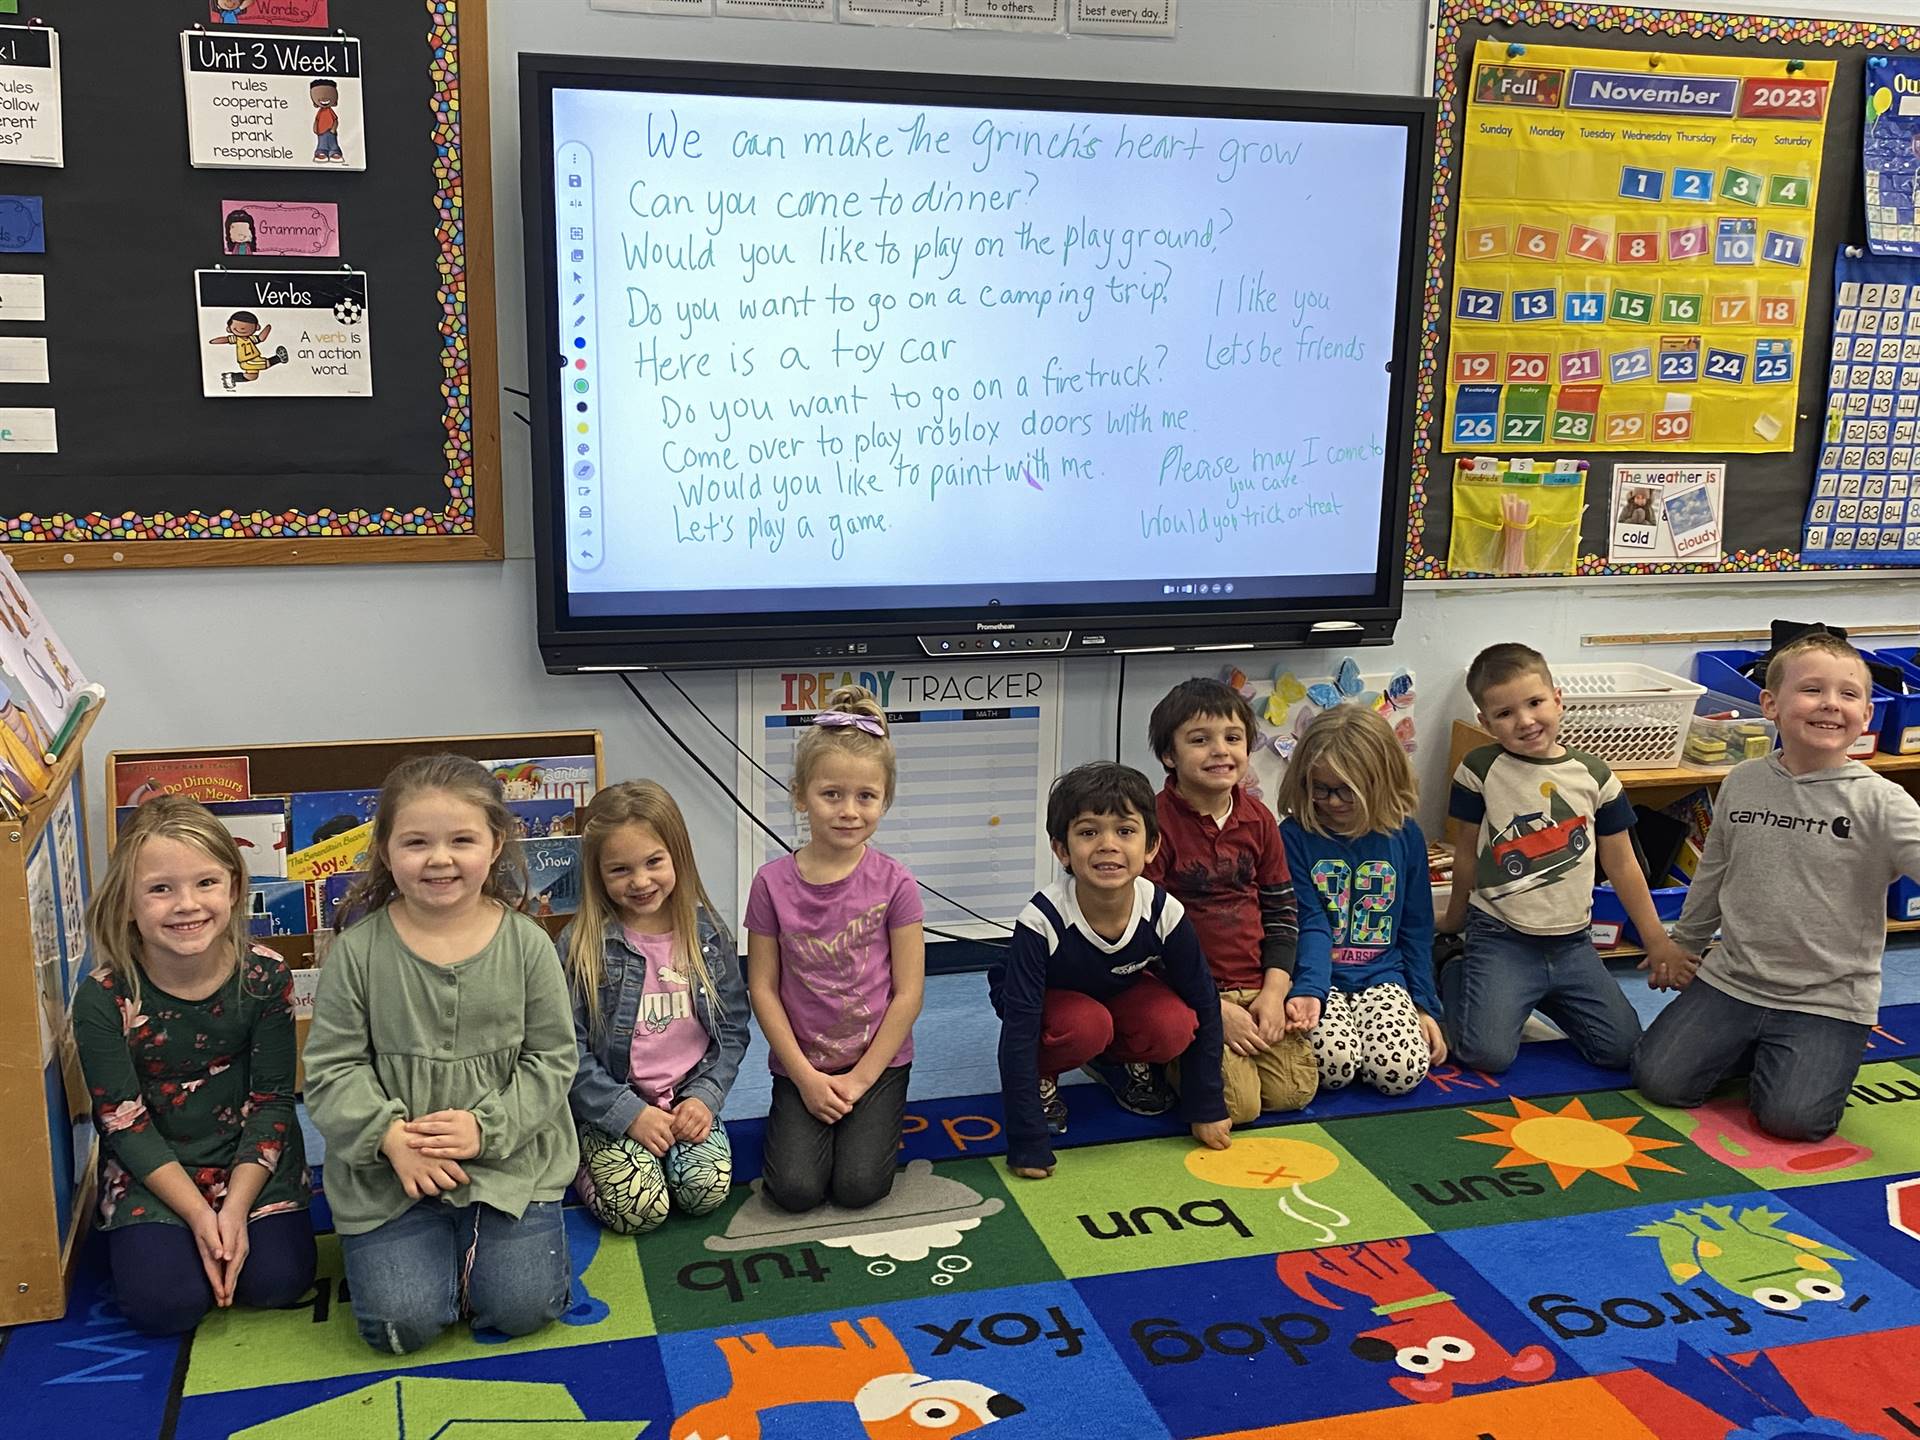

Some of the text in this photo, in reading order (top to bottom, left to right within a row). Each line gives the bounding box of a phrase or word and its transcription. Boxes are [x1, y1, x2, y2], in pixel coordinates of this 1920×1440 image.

[256, 0, 299, 16] Words
[988, 1, 1036, 14] to others.
[1086, 7, 1161, 22] best every day.
[198, 41, 246, 70] Unit
[251, 43, 269, 70] 3
[274, 44, 338, 74] Week
[231, 78, 269, 92] rules
[1501, 79, 1817, 109] Fall November 2023
[213, 94, 289, 112] cooperate
[231, 112, 274, 128] guard
[231, 128, 274, 144] prank
[648, 109, 703, 159] We
[733, 130, 787, 160] can
[804, 117, 894, 159] make
[1114, 123, 1207, 161] heart
[1216, 137, 1303, 184] grow
[1480, 123, 1813, 149] Sunday Monday Tuesday Wednesday Thursday Friday Saturday
[213, 144, 294, 162] responsible
[1732, 176, 1749, 196] 3
[629, 170, 1040, 236] Can you come to dinner?
[258, 221, 322, 238] Grammar
[621, 231, 717, 272] Would
[739, 244, 796, 283] you
[820, 226, 869, 266] like
[873, 230, 901, 265] to
[913, 226, 963, 281] play
[974, 234, 1005, 258] on
[1014, 220, 1056, 256] the
[1723, 239, 1749, 258] 10
[255, 281, 313, 307] Verbs
[1237, 269, 1279, 315] like
[1292, 286, 1332, 329] you
[628, 286, 662, 329] Do
[676, 299, 721, 340] you
[739, 284, 818, 319] want
[824, 282, 855, 313] to
[864, 296, 897, 332] go
[907, 288, 938, 309] on
[946, 286, 968, 308] a
[979, 280, 1096, 323] camping
[1720, 299, 1743, 318] 17
[300, 330, 362, 344] A verb is
[1258, 334, 1283, 369] be
[1294, 325, 1368, 362] friends
[240, 341, 256, 357] 27
[297, 346, 362, 360] an action
[633, 329, 958, 386] Here is a toy car
[1856, 343, 1874, 358] 22
[1462, 358, 1491, 377] 19
[661, 395, 698, 430] Do
[708, 400, 774, 442] you
[788, 384, 869, 419] want
[889, 382, 922, 409] to
[931, 385, 960, 424] go
[972, 376, 1003, 400] on
[1016, 373, 1029, 398] a
[662, 440, 740, 475] Come
[748, 438, 805, 463] over
[817, 424, 845, 458] to
[854, 421, 903, 467] play
[917, 406, 1001, 447] roblox
[1021, 409, 1093, 437] doors
[1107, 403, 1154, 437] with
[1459, 419, 1493, 437] 26
[1159, 432, 1384, 487] Please may I come to
[1867, 451, 1886, 466] 63
[677, 472, 763, 509] Would
[773, 472, 822, 512] you
[836, 460, 884, 495] like
[894, 454, 921, 488] to
[931, 454, 1001, 501] paint
[1005, 446, 1051, 482] with
[1619, 470, 1716, 484] The weather is
[1225, 476, 1256, 510] you
[1140, 504, 1209, 540] Would
[1240, 505, 1284, 531] trick
[1288, 504, 1304, 519] or
[1304, 492, 1344, 518] treat
[673, 504, 734, 544] Let's
[748, 508, 786, 553] play
[797, 517, 815, 540] a
[1622, 529, 1650, 545] cold
[1835, 531, 1853, 546] 92
[1677, 528, 1720, 552] cloudy
[976, 622, 1016, 631] Promethean
[902, 671, 1043, 702] TRACKER
[888, 714, 904, 723] ELA
[976, 710, 998, 718] MATH
[164, 775, 244, 796] Do Dinosaurs
[543, 767, 590, 782] Santa's
[1729, 808, 1828, 835] carhartt
[312, 857, 338, 877] Joy
[340, 855, 349, 866] of
[536, 850, 571, 872] Snow
[1411, 1170, 1547, 1208] sun
[1076, 1197, 1256, 1242] bun
[677, 1247, 832, 1302] tub
[1527, 1286, 1753, 1341] frog
[914, 1305, 1087, 1359] fox
[1129, 1311, 1332, 1368] dog
